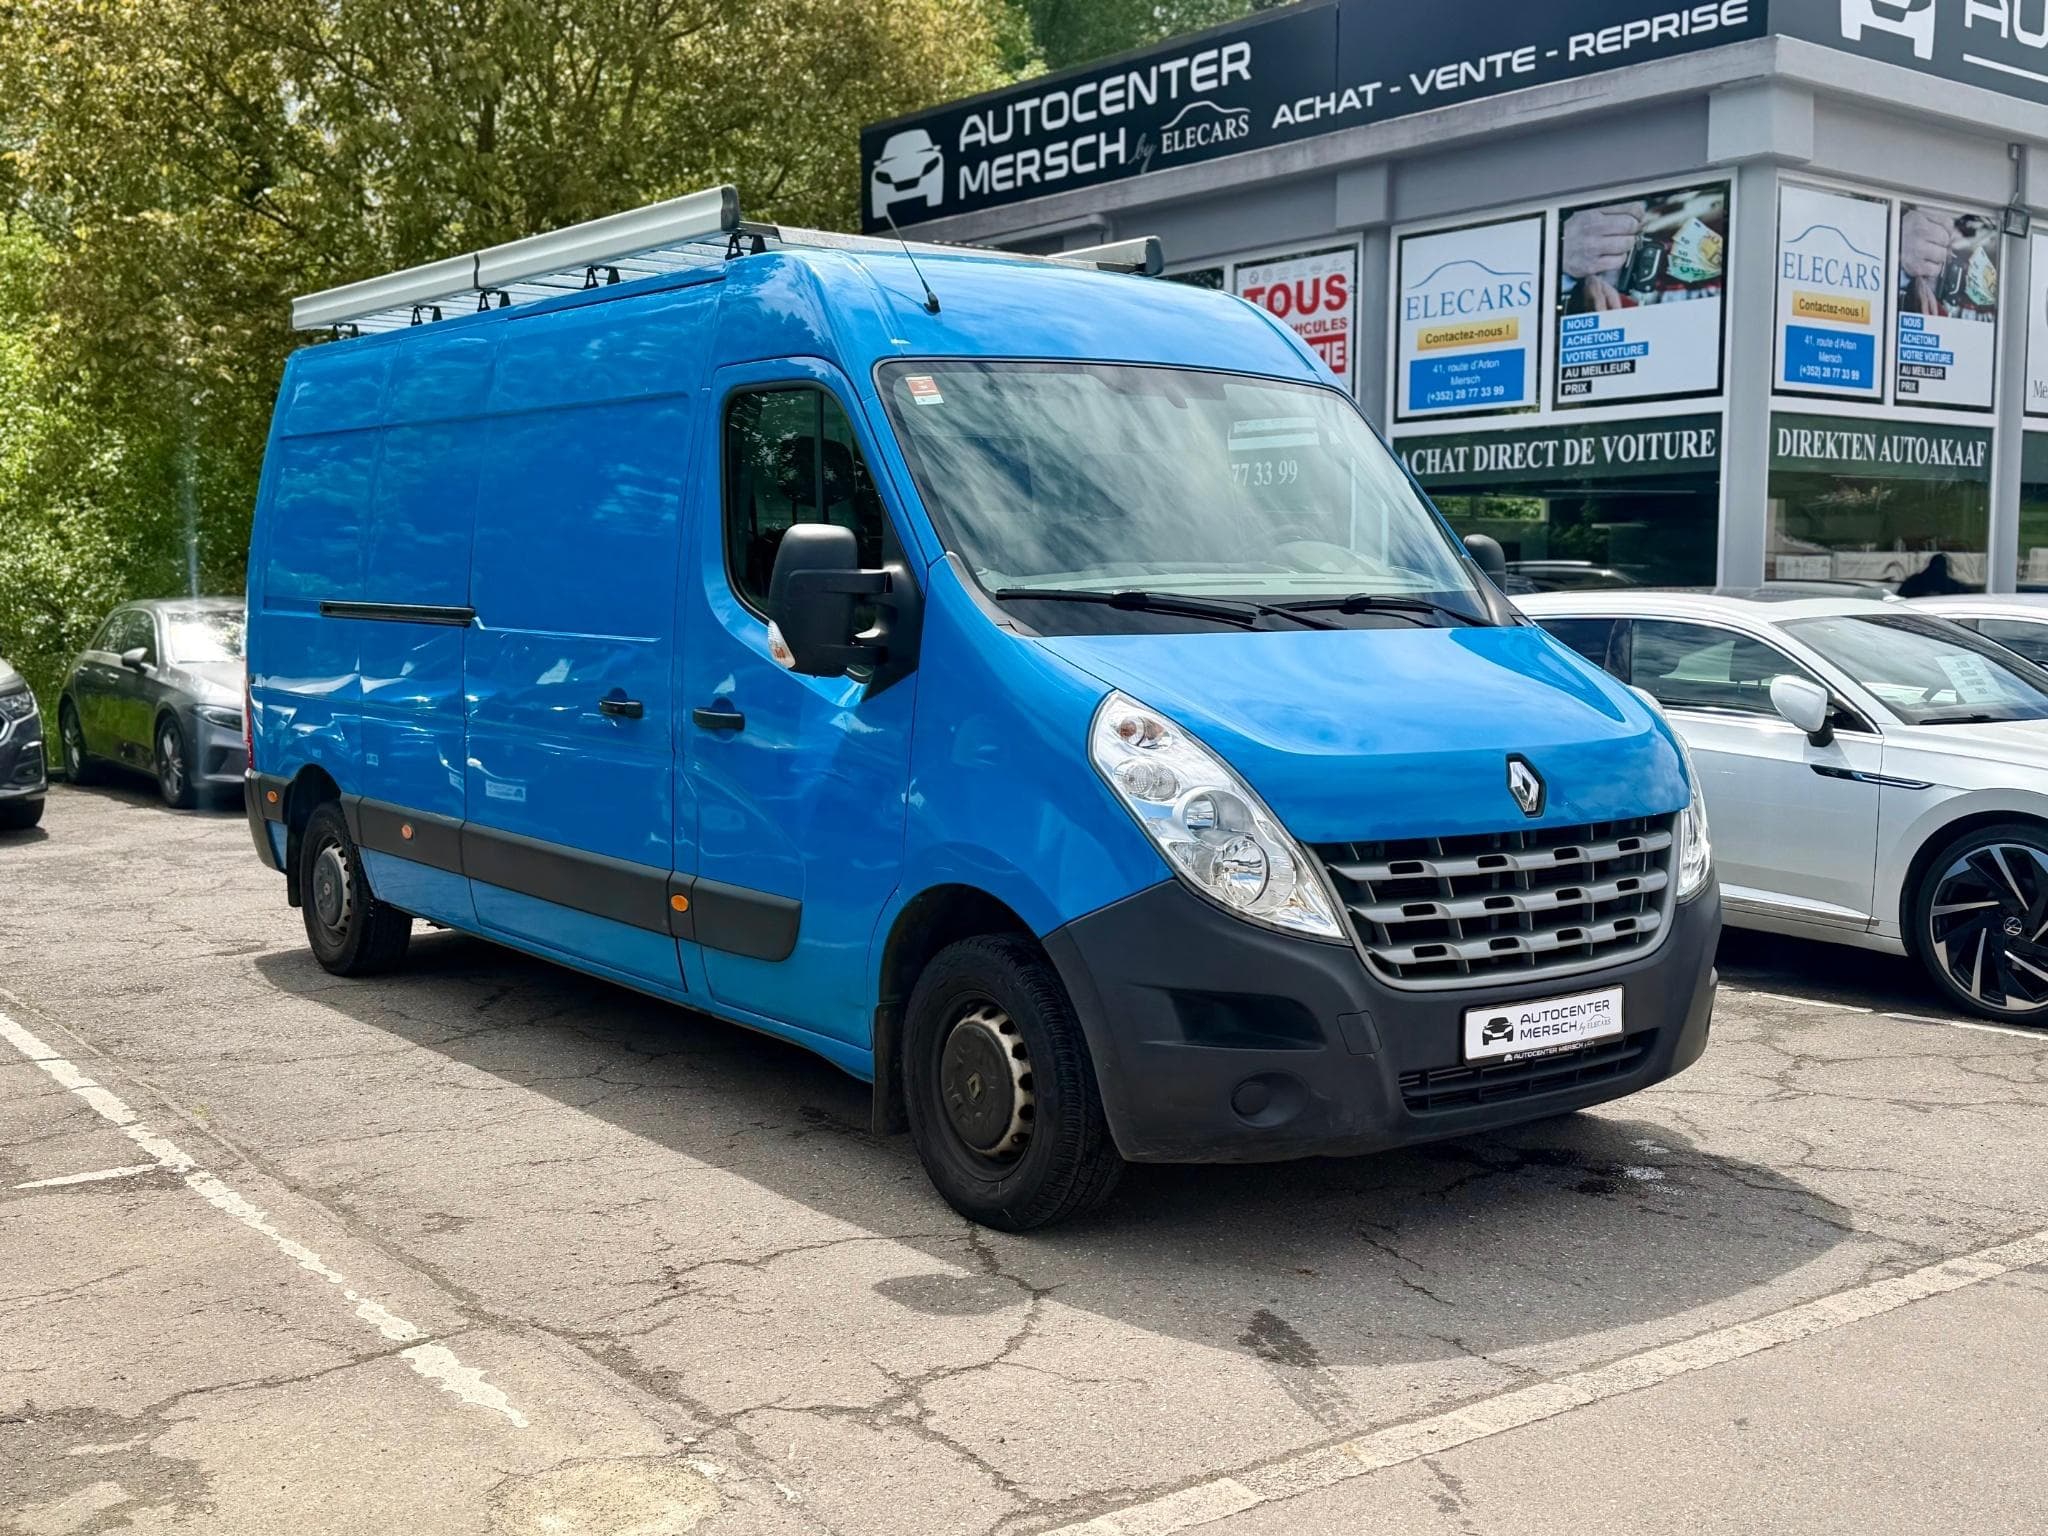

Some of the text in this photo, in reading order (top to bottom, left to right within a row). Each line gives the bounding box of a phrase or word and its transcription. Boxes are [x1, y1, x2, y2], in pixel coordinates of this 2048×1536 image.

[1271, 82, 1382, 129] ACHAT
[1409, 45, 1537, 95] VENTE
[1568, 0, 1749, 61] REPRISE
[958, 40, 1252, 152] AUTOCENTER
[959, 113, 1250, 200] MERSCH by ELECARS
[1783, 251, 1881, 292] ELECARS
[1243, 273, 1348, 319] TOUS
[1405, 280, 1532, 321] ELECARS
[1799, 298, 1860, 317] Contactez-nous
[1290, 317, 1348, 335] HICULES
[1566, 318, 1594, 330] NOUS
[1903, 317, 1922, 329] NOUS
[1425, 327, 1503, 345] Contactez-nous
[1565, 331, 1620, 347] ACHETONS
[1902, 334, 1937, 347] ACHETONS
[1565, 344, 1644, 363] VOTRE VOITURE
[1902, 349, 1952, 364] VOTRE VOITURE
[1447, 362, 1469, 373] route
[1565, 362, 1631, 378] AU MEILLEUR
[1901, 365, 1944, 378] AU MEILLEUR
[1450, 375, 1481, 386] Mersch
[1565, 382, 1588, 394] PRIX
[1901, 381, 1917, 392] PRIX
[1427, 385, 1505, 404] (+352) 28 77 33 99
[1401, 428, 1716, 476] ACHAT DIRECT DE VOITURE
[1777, 428, 1987, 467] DIREKTEN AUTOAKAAF
[1231, 459, 1298, 487] 77 33 99
[1520, 999, 1610, 1025] AUTOCENTER
[1520, 1020, 1577, 1040] MERSCH
[1513, 1047, 1558, 1059] AUTOCENTER
